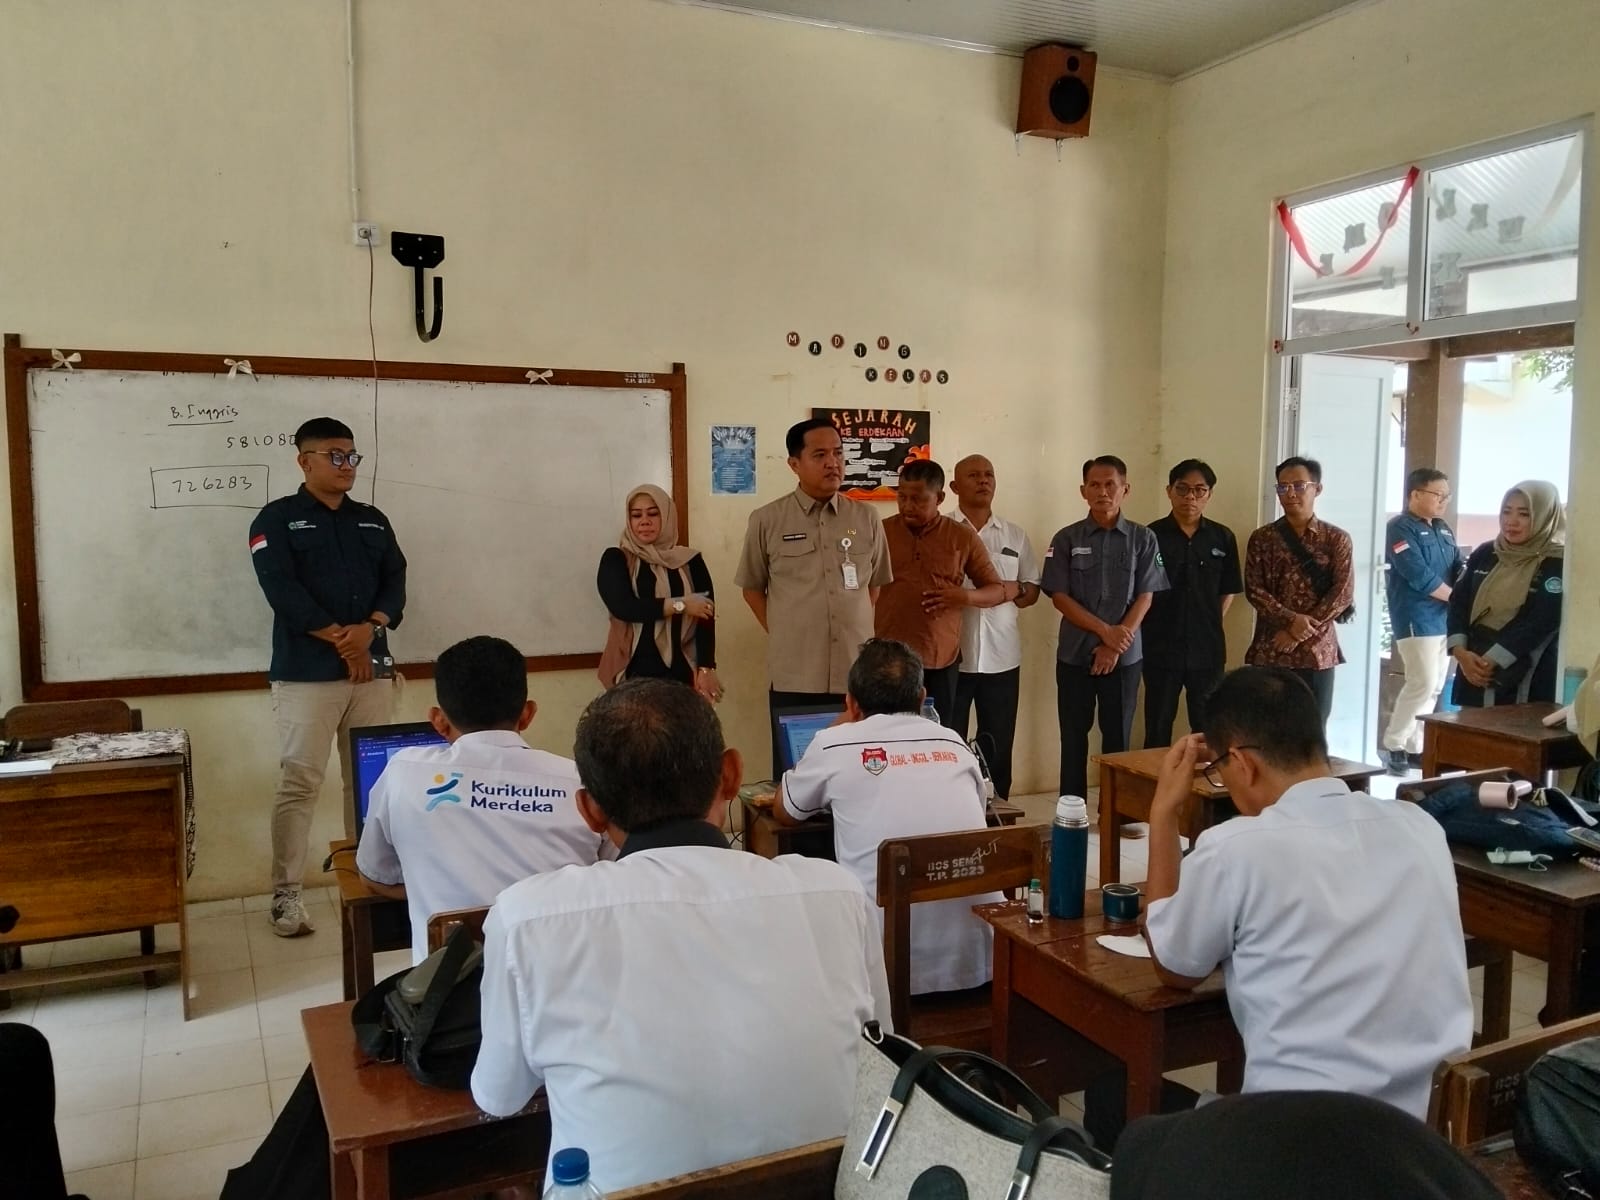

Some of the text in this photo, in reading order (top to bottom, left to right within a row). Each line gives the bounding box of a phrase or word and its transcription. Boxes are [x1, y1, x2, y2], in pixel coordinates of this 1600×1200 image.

[787, 332, 910, 359] MADING
[170, 405, 183, 419] B.
[832, 409, 917, 434] SEJARAH
[171, 476, 253, 493] 726283
[470, 779, 567, 799] Kurikulum
[470, 795, 553, 813] Merdeka
